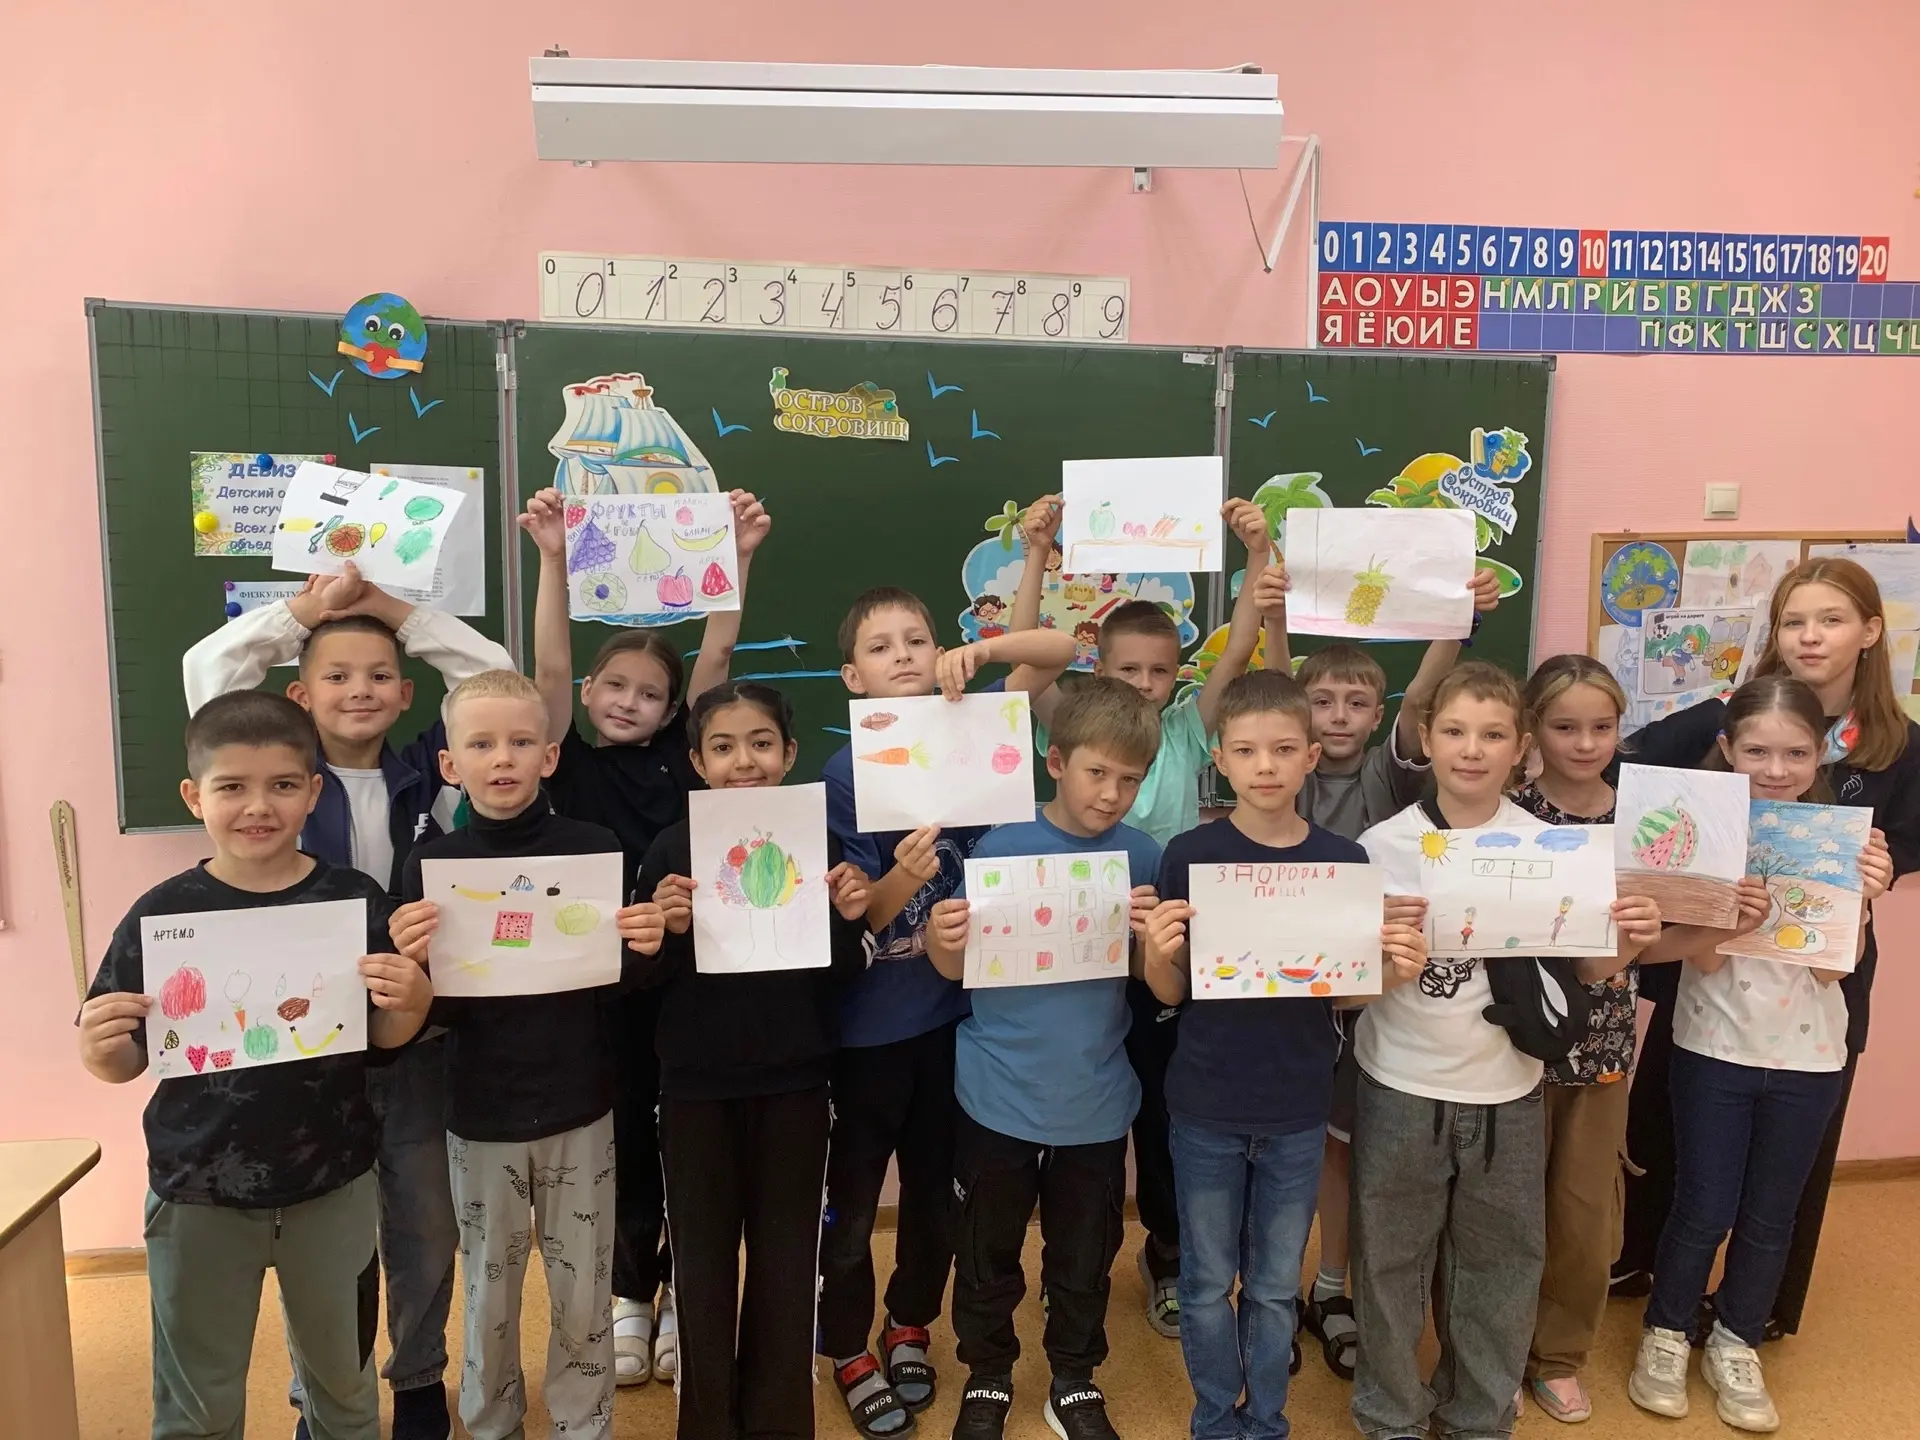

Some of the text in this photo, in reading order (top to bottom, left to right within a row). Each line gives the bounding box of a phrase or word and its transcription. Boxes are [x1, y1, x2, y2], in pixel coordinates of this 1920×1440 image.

[1323, 230, 1887, 276] 0 1 2 3 4 5 6 7 8 9 10 11 12 13 14 15 16 17 18 19 20
[545, 259, 1082, 298] 0 1 2 3 4 5 6 7 8 9
[576, 272, 1125, 338] 0 1 2 3 4 5 6 7 8 9
[1322, 277, 1814, 316] А О У Ы Э Н М Л Р Й Б В Г Д Ж З
[1323, 312, 1472, 345] Я Ё Ю И Е
[1640, 322, 1660, 347] П
[1668, 321, 1694, 348] Ф
[1703, 322, 1723, 348] К
[1734, 323, 1752, 348] Т
[1760, 323, 1786, 349] Ш
[1793, 323, 1814, 349] С
[1823, 324, 1844, 349] Х
[1854, 324, 1876, 352] Ц
[1886, 324, 1903, 349] Ч
[778, 390, 864, 414] ОСТРОВ
[778, 412, 908, 440] СОКРОВИЩ
[216, 486, 274, 499] Детский
[1459, 466, 1511, 505] Остров
[233, 505, 281, 517] не скуч
[591, 501, 667, 519] ФРУКТЫ
[1442, 473, 1512, 527] Сокровищ
[234, 522, 267, 534] Всех
[684, 528, 711, 537] БАНАН
[230, 538, 271, 551] объед
[1480, 860, 1534, 875] 10 8
[966, 1391, 1010, 1403] ANTILOPA
[1060, 1391, 1102, 1407] ANTILOPA
